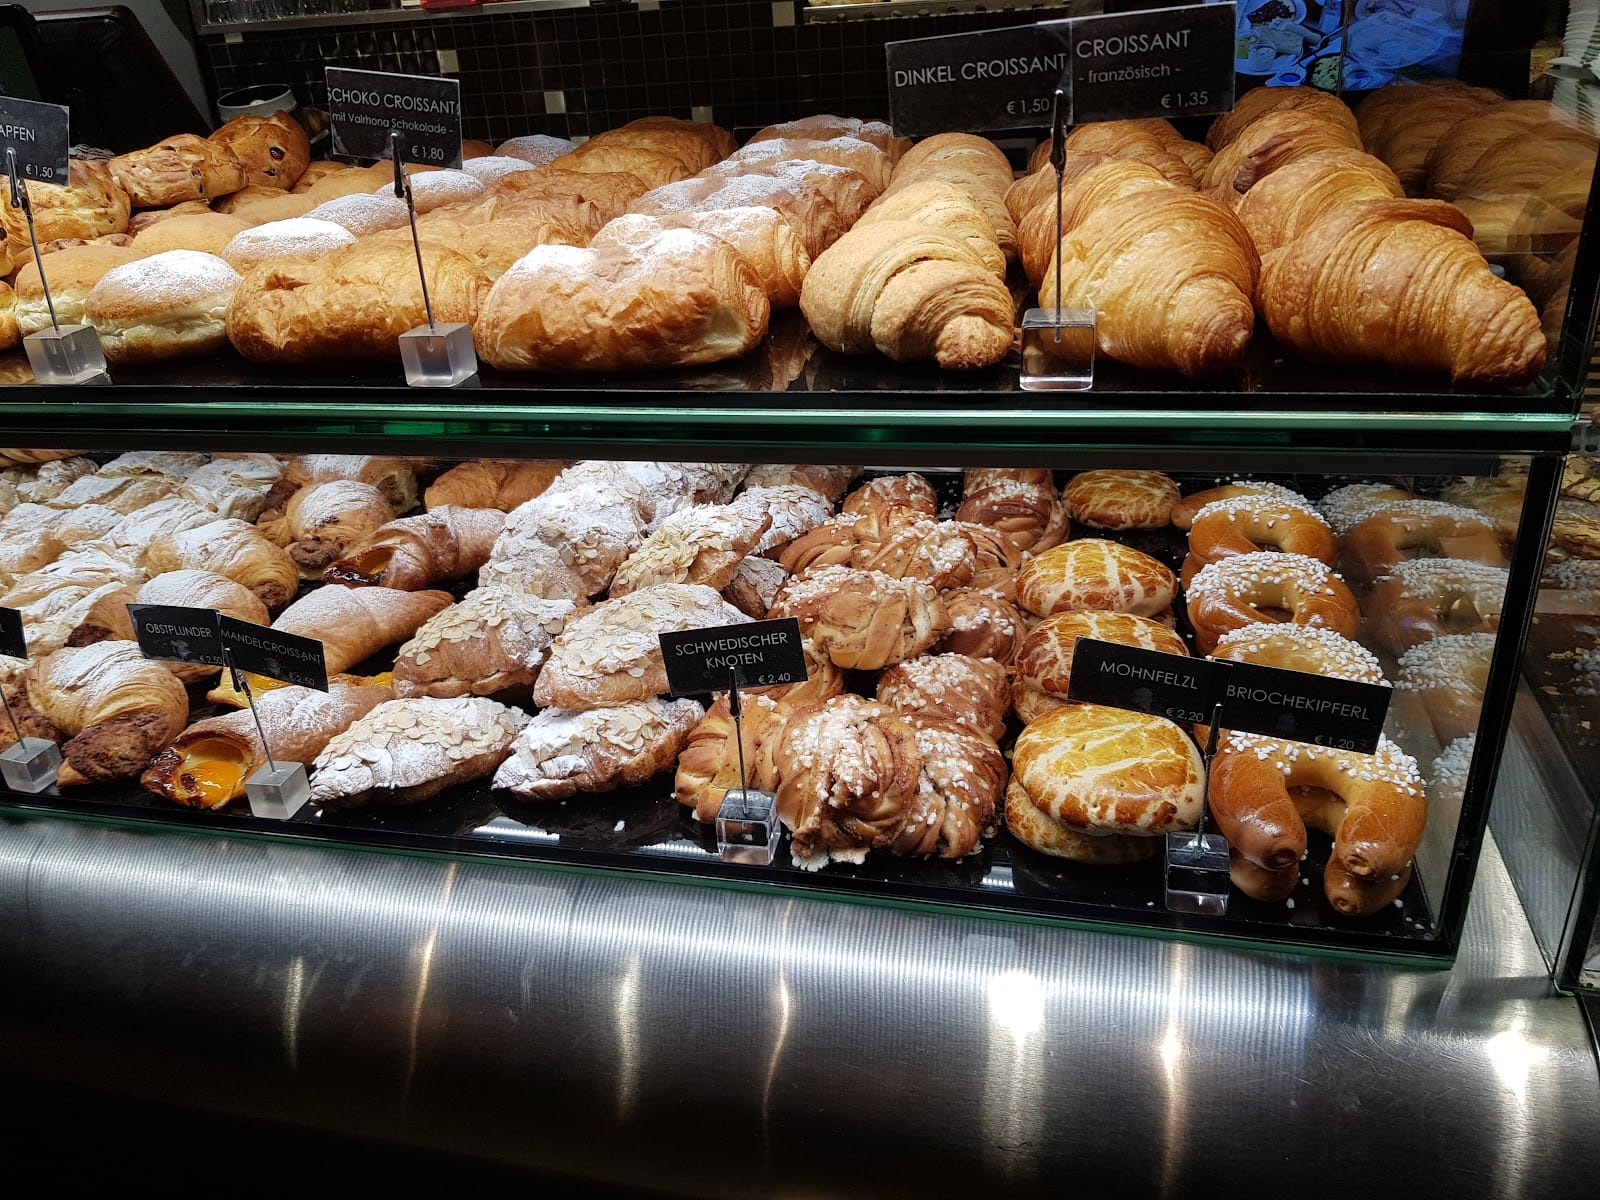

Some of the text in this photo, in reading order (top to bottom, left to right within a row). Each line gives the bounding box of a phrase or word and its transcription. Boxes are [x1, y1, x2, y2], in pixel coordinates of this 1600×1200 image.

[1076, 30, 1191, 58] CROISSANT
[895, 53, 1067, 87] DINKEL CROISSANT
[1088, 63, 1171, 83] französisch
[1006, 98, 1050, 114] € 1,50
[1161, 91, 1208, 108] € 1,35
[333, 111, 346, 122] mit
[391, 117, 447, 135] Schokolade
[412, 145, 419, 158] €
[26, 163, 32, 175] €
[145, 622, 213, 638] OBSTPLUNDER
[220, 629, 322, 664] MANDELCROISSANT
[675, 632, 788, 656] SCHWEDISCHER
[706, 652, 764, 669] KNOTEN
[758, 675, 766, 684] €
[1100, 660, 1198, 690] MOHNFELZL
[1226, 685, 1370, 721] BRIOCHEKIPFERL
[1166, 707, 1175, 717] €
[1314, 735, 1325, 745] €
